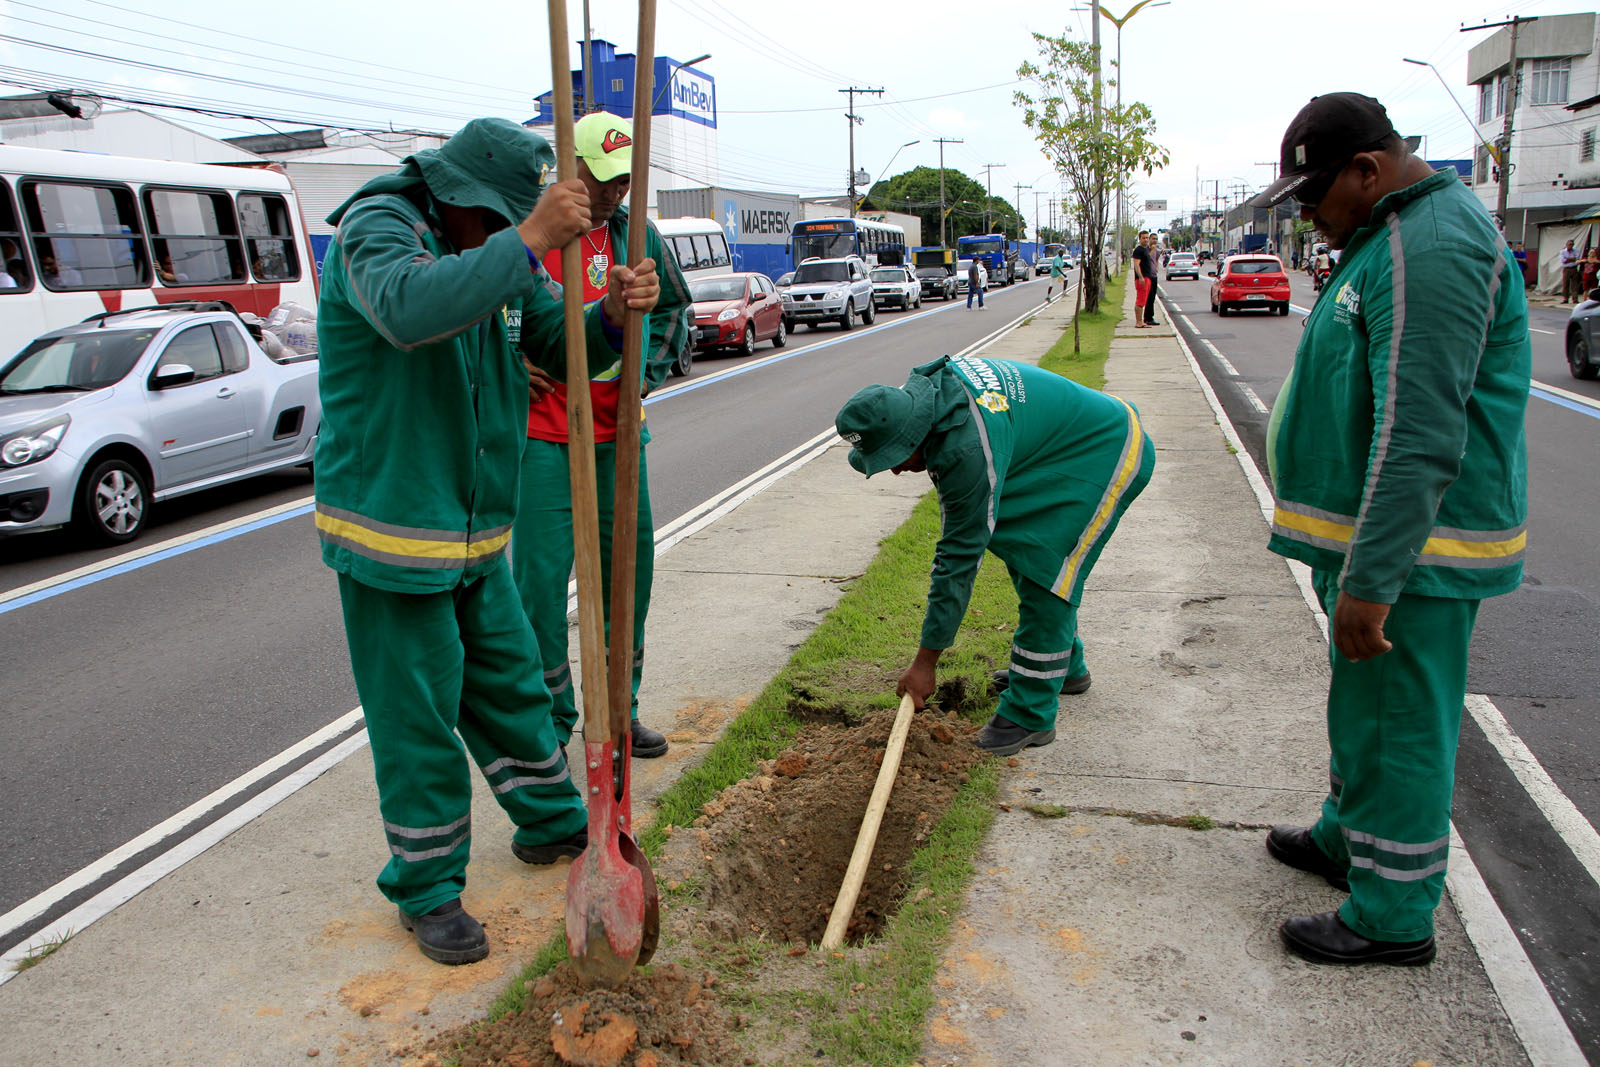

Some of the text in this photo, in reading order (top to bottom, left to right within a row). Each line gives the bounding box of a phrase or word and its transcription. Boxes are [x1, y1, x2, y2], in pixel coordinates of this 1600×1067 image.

[673, 74, 712, 112] AmBev
[1270, 175, 1309, 203] MARESIA
[741, 209, 791, 234] MAERSK
